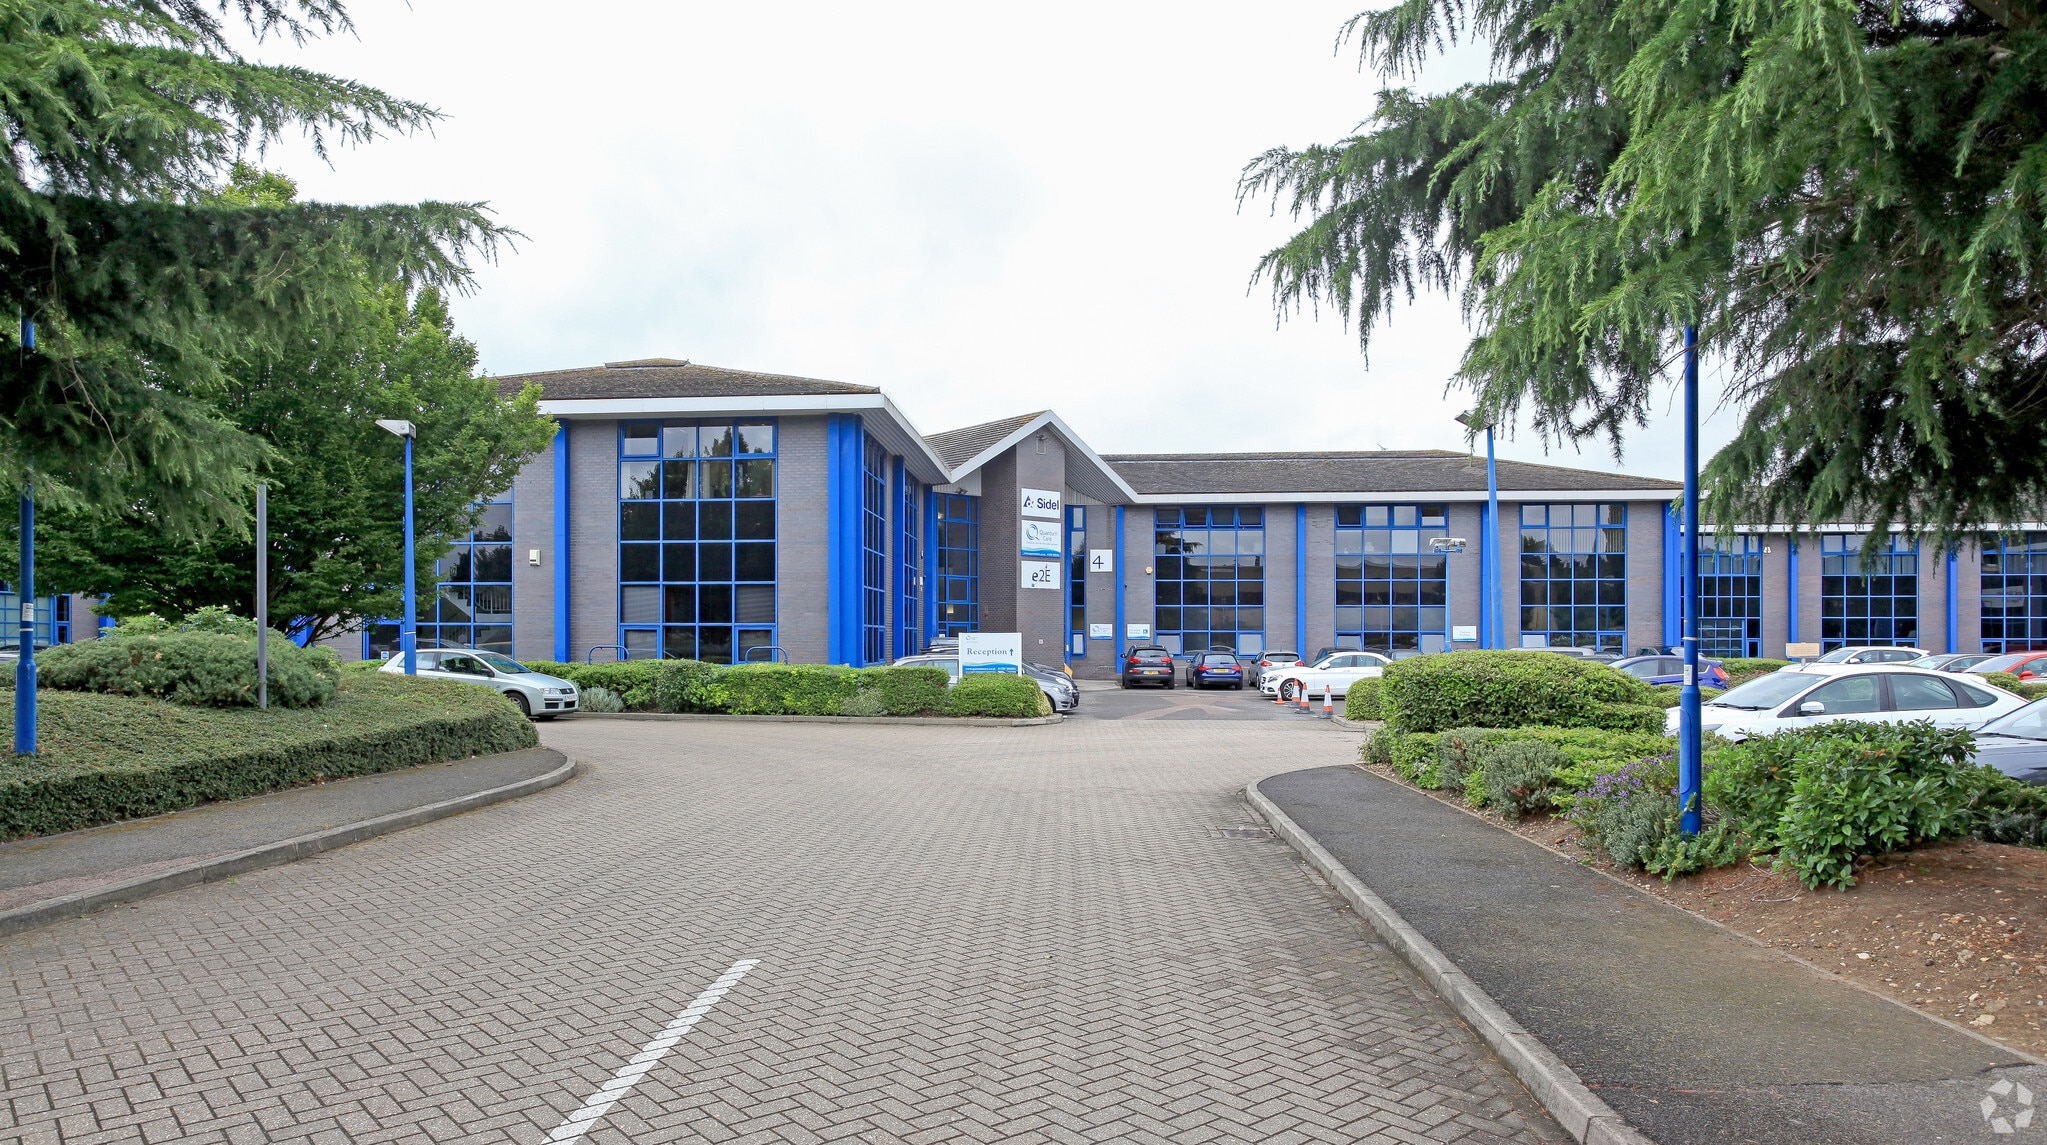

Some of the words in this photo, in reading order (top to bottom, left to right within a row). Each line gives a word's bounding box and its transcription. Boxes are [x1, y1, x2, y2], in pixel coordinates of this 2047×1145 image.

[1037, 498, 1059, 510] Sidel
[1092, 555, 1104, 569] 4
[967, 648, 1007, 656] Reception
